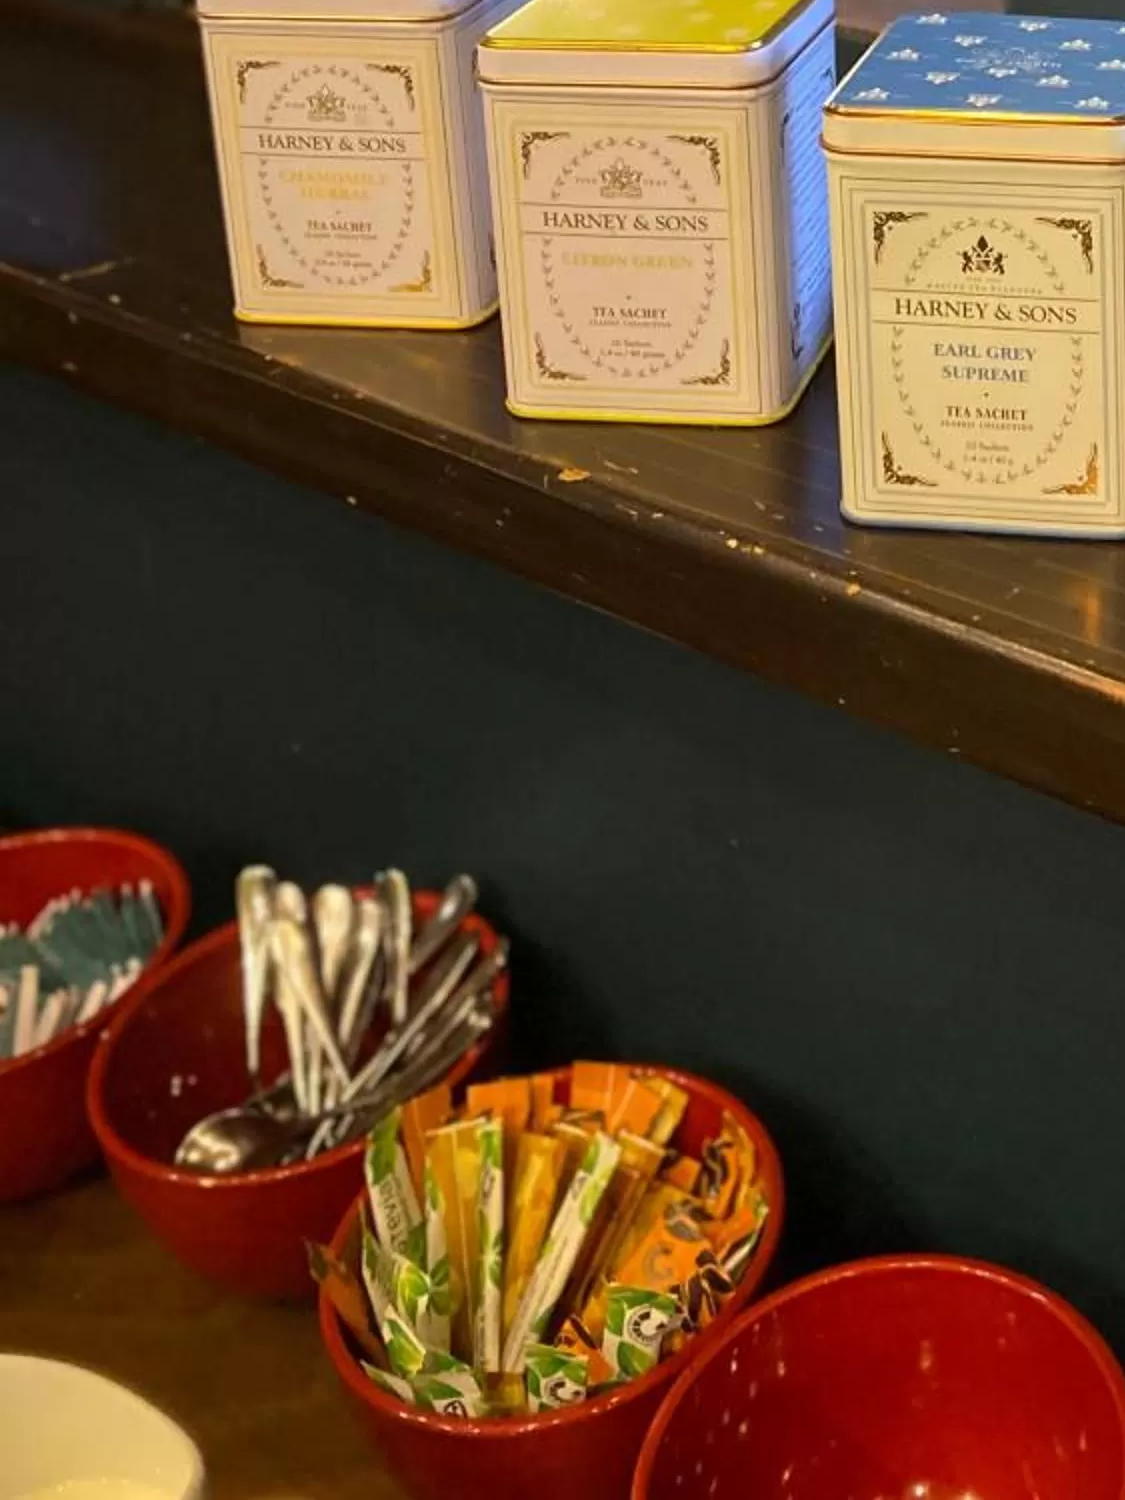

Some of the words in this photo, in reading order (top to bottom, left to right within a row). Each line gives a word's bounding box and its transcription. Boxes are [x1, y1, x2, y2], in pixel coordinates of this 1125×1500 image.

[258, 133, 334, 151] HARNEY
[339, 136, 353, 151] &
[357, 136, 407, 153] SONS
[541, 211, 628, 231] HARNEY
[633, 214, 651, 231] &
[655, 215, 710, 233] SONS
[591, 305, 616, 318] TEA
[619, 307, 669, 320] SACHET
[894, 297, 990, 320] HARNEY
[993, 302, 1013, 322] &
[1018, 304, 1078, 326] SONS
[933, 342, 982, 359] EARL
[985, 346, 1037, 362] GREY
[941, 364, 1030, 384] SUPREME
[945, 405, 972, 419] TEA
[975, 407, 1029, 421] SACHET
